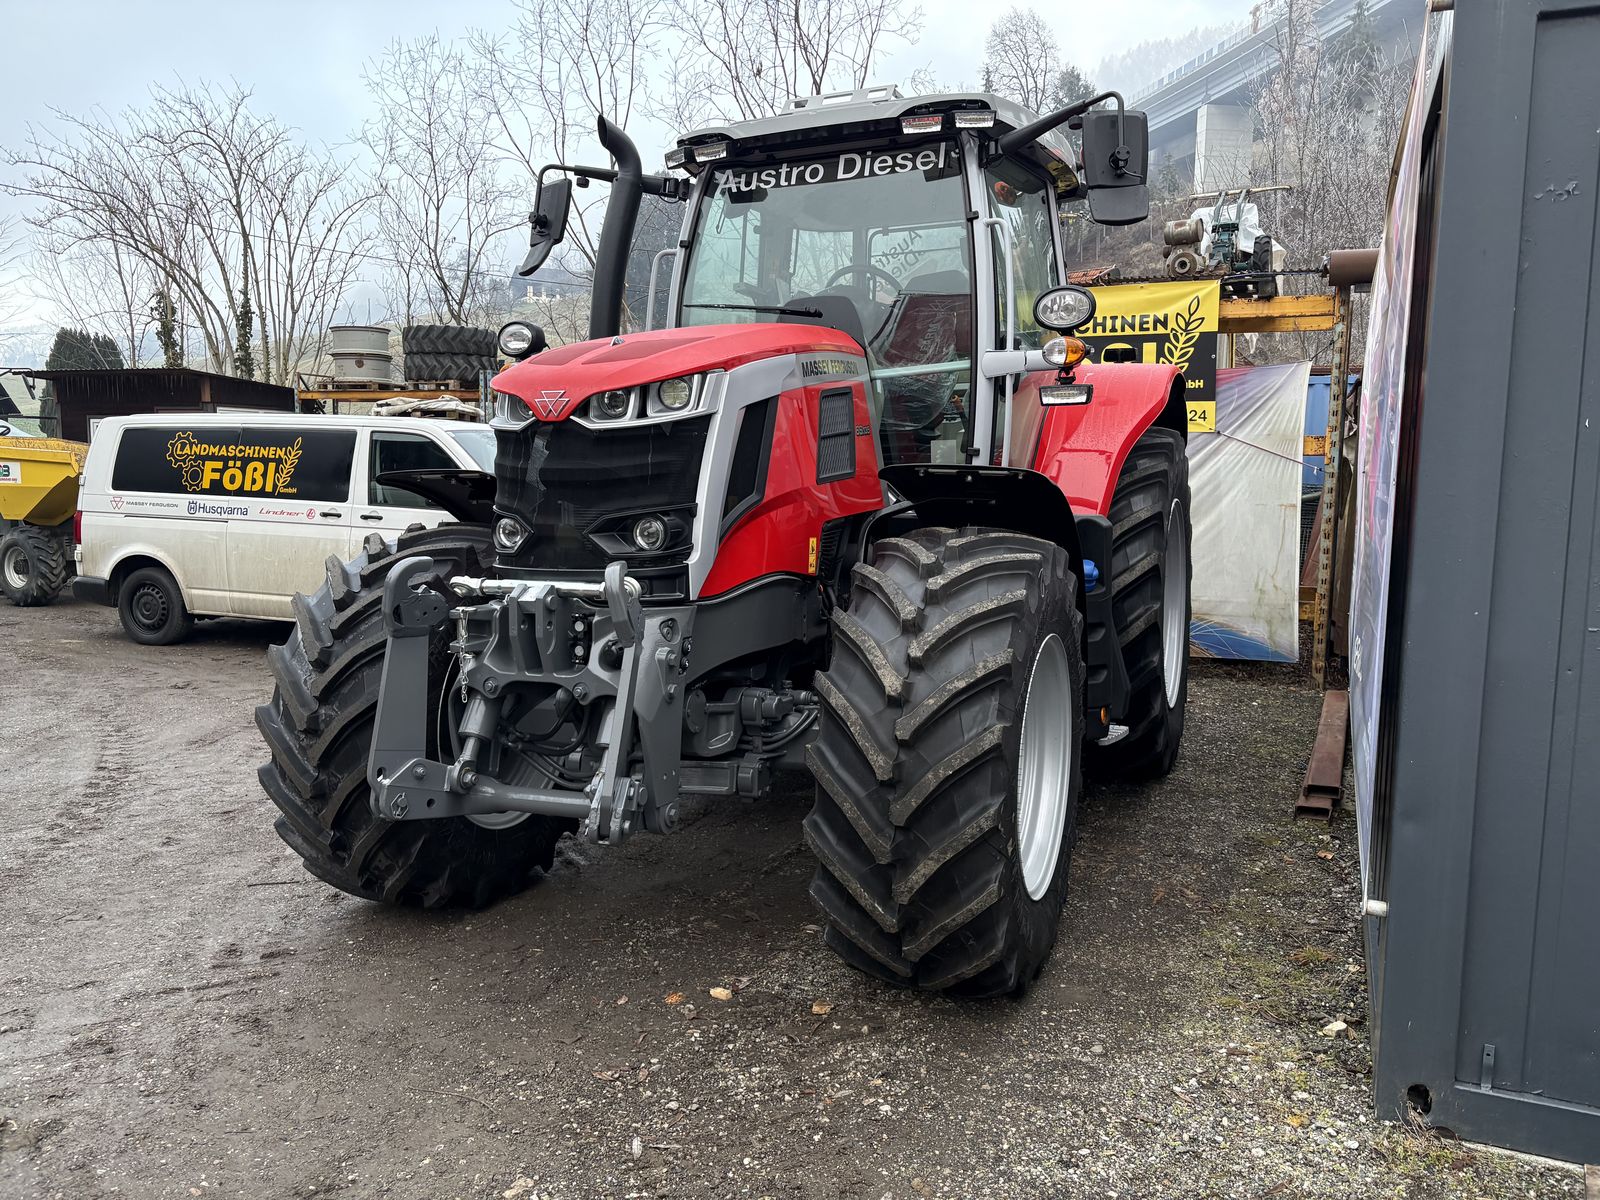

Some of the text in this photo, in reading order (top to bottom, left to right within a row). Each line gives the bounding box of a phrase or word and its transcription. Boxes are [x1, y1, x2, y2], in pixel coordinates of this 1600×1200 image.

[718, 142, 946, 193] Austro Diesel
[801, 360, 830, 378] MASSEY
[1189, 410, 1208, 422] 24
[176, 443, 286, 459] LANDMASCHINEN
[202, 460, 276, 493] Fößl
[279, 486, 298, 494] GmbH
[198, 503, 249, 516] Husqvarna
[259, 507, 303, 516] Lindner
